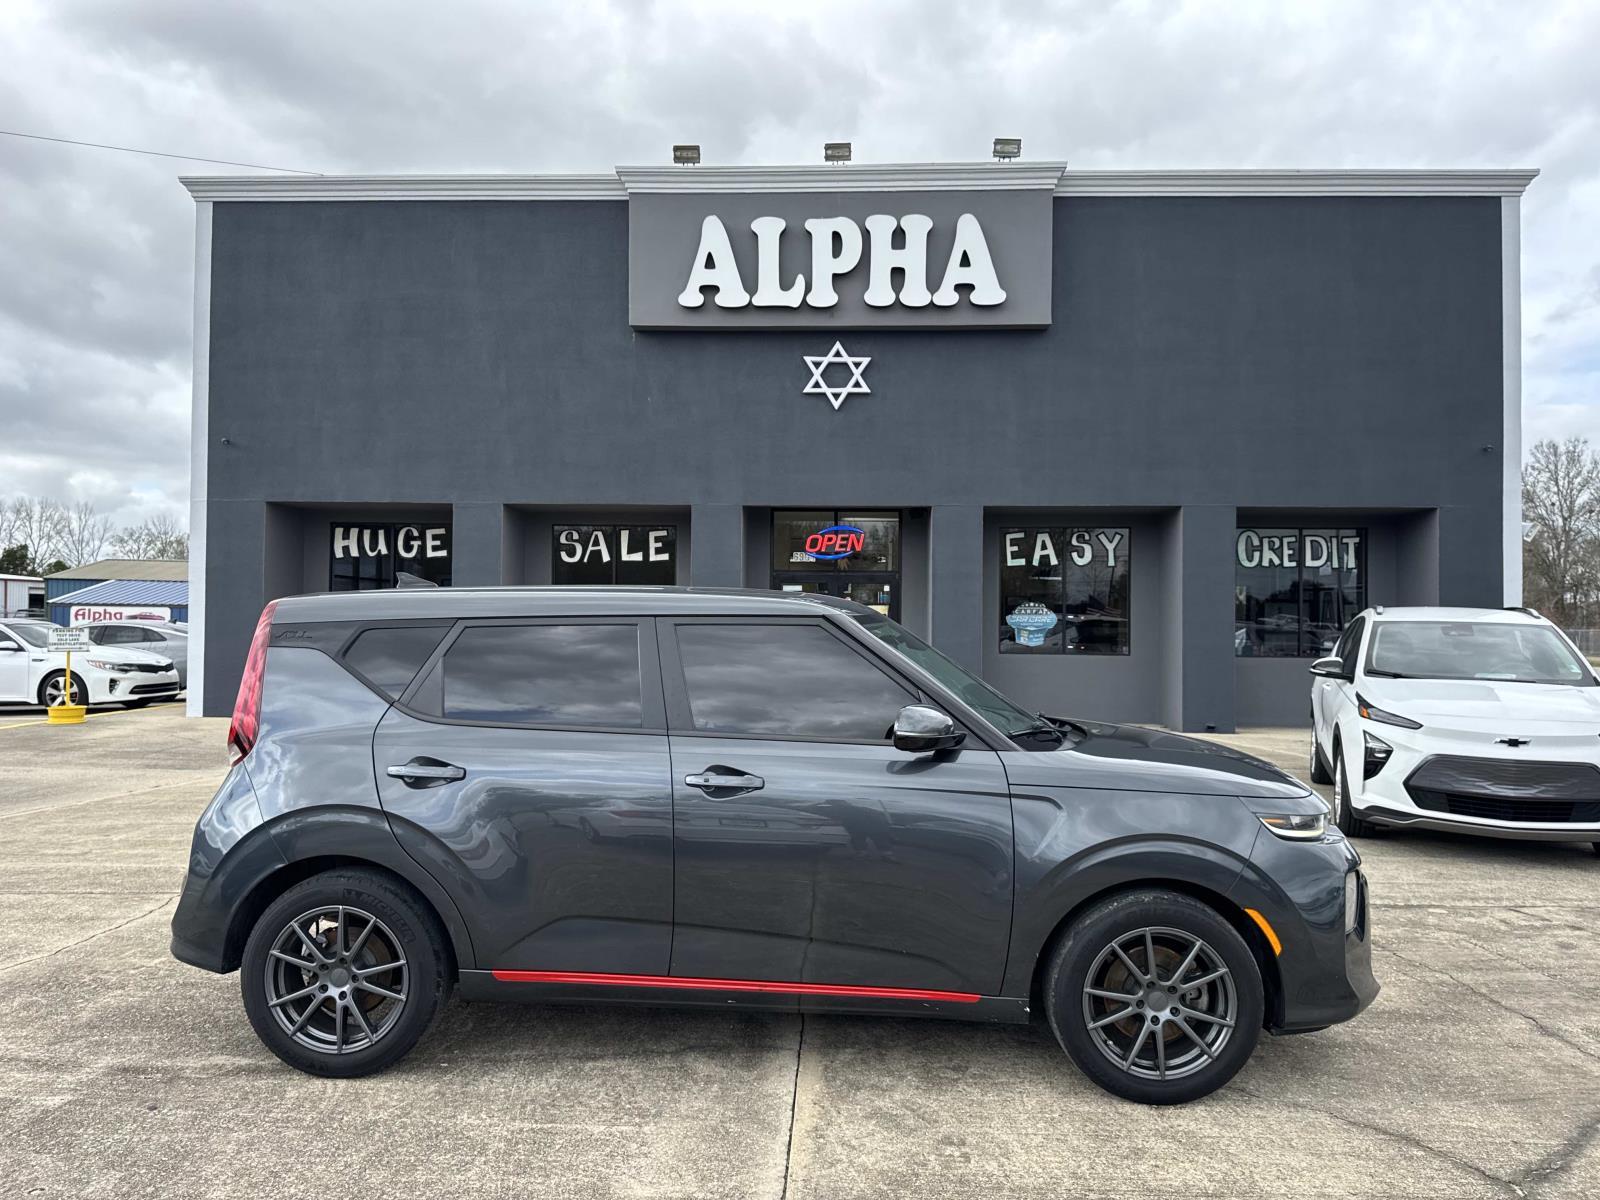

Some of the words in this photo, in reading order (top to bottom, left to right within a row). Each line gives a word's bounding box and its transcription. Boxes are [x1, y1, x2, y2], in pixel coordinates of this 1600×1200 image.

[678, 213, 1007, 308] ALPHA
[334, 527, 448, 559] HUGE
[559, 529, 669, 564] SALE
[805, 533, 865, 552] OPEN
[1005, 531, 1124, 567] EASY
[1237, 530, 1360, 569] CREDIT
[74, 608, 123, 622] Alpha
